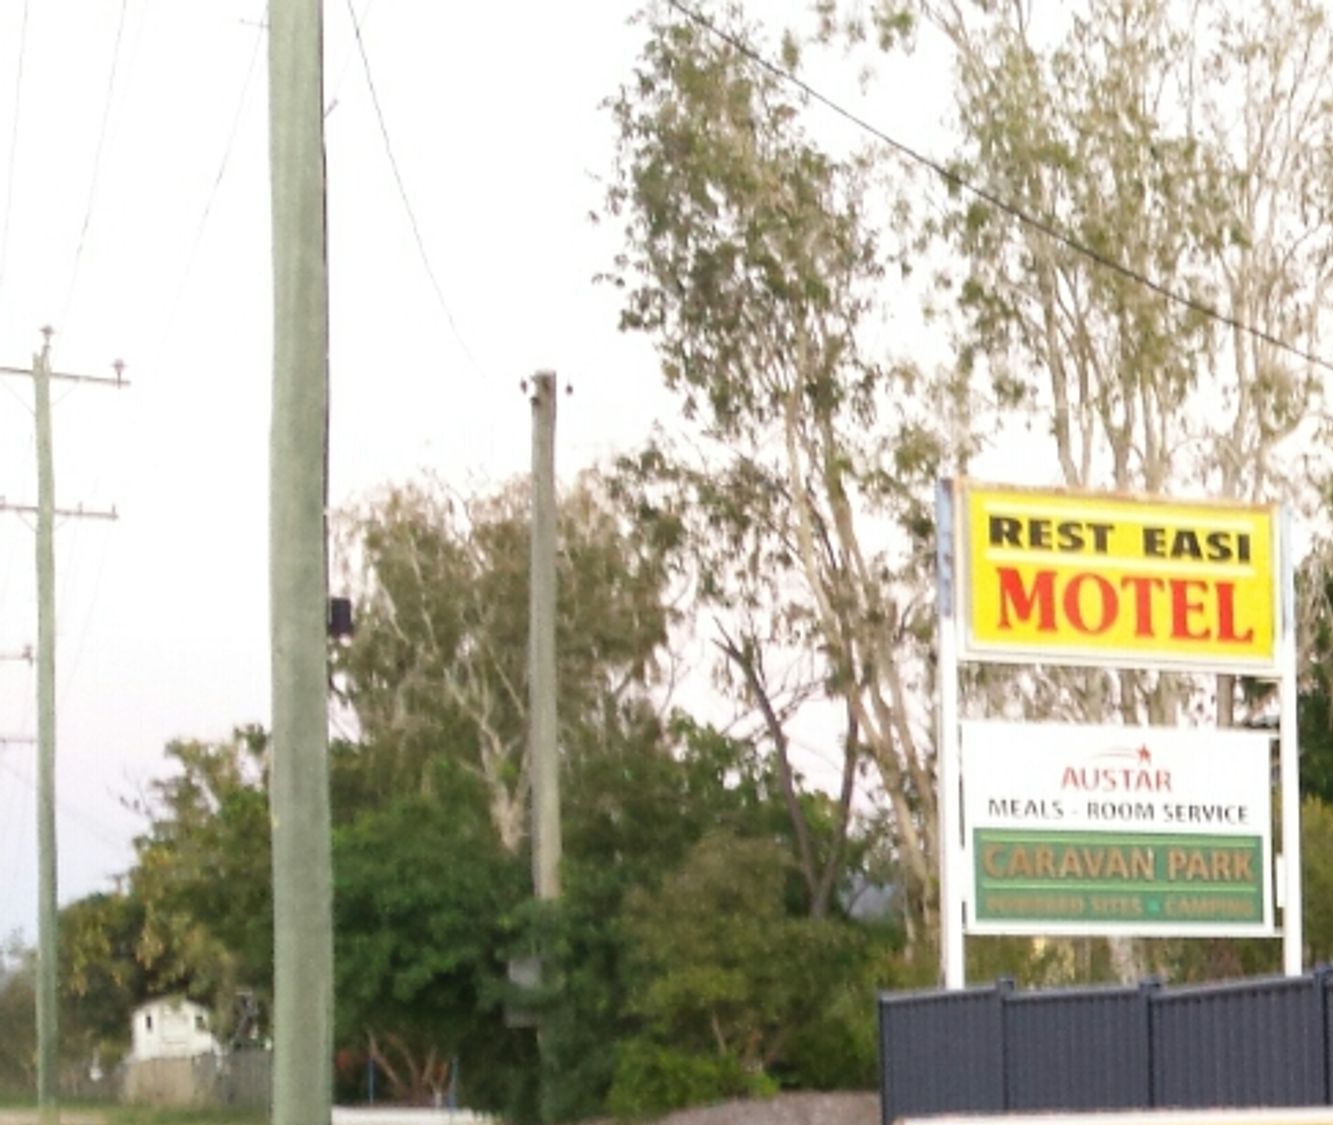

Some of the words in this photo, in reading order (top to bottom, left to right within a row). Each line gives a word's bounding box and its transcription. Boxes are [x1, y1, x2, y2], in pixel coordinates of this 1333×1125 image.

[988, 514, 1115, 555] REST
[1143, 526, 1251, 564] EASI
[996, 566, 1254, 645] MOTEL
[1061, 766, 1173, 793] AUSTAR
[988, 798, 1064, 820] MEALS
[1087, 802, 1155, 823] ROOM
[1163, 804, 1250, 825] SERVICE
[982, 844, 1156, 881] CARAVAN
[1167, 848, 1254, 883] PARK
